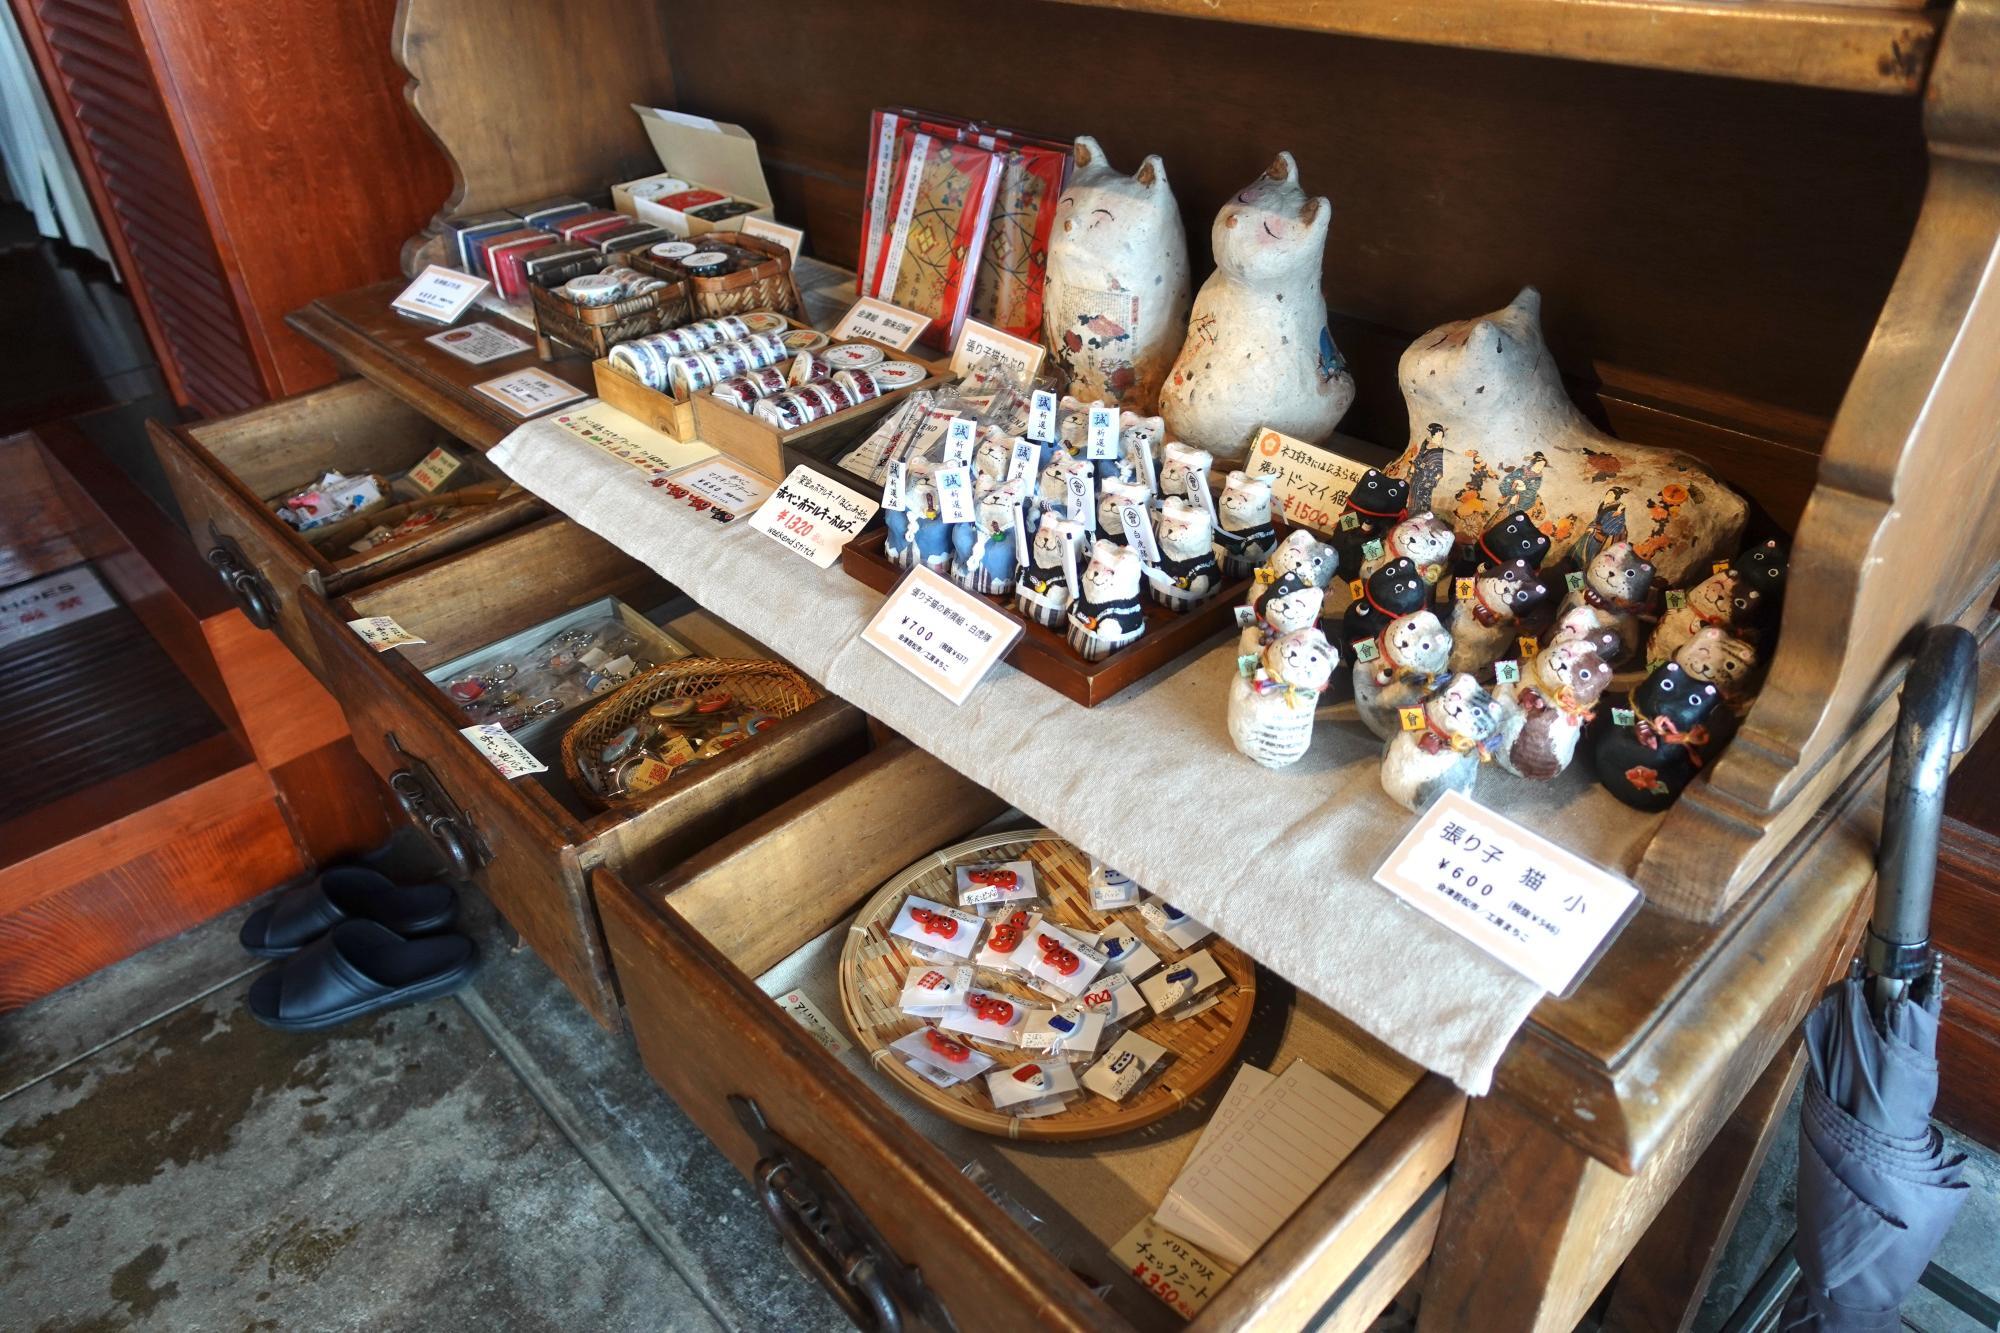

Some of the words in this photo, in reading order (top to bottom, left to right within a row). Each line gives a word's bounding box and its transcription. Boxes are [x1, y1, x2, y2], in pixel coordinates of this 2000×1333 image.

[708, 471, 758, 497] マスキングテープ
[1280, 444, 1361, 484] ネコ好きにはたまらな
[1330, 489, 1350, 507] 猫
[900, 615, 934, 642] ¥700
[1437, 857, 1494, 897] ¥600
[1438, 820, 1506, 865] 張り子
[1518, 865, 1547, 892] 猫
[1562, 893, 1588, 915] 小
[1131, 1262, 1179, 1304] ¥350
[1136, 1241, 1209, 1299] チェックシート
[1190, 1258, 1215, 1281] マリス
